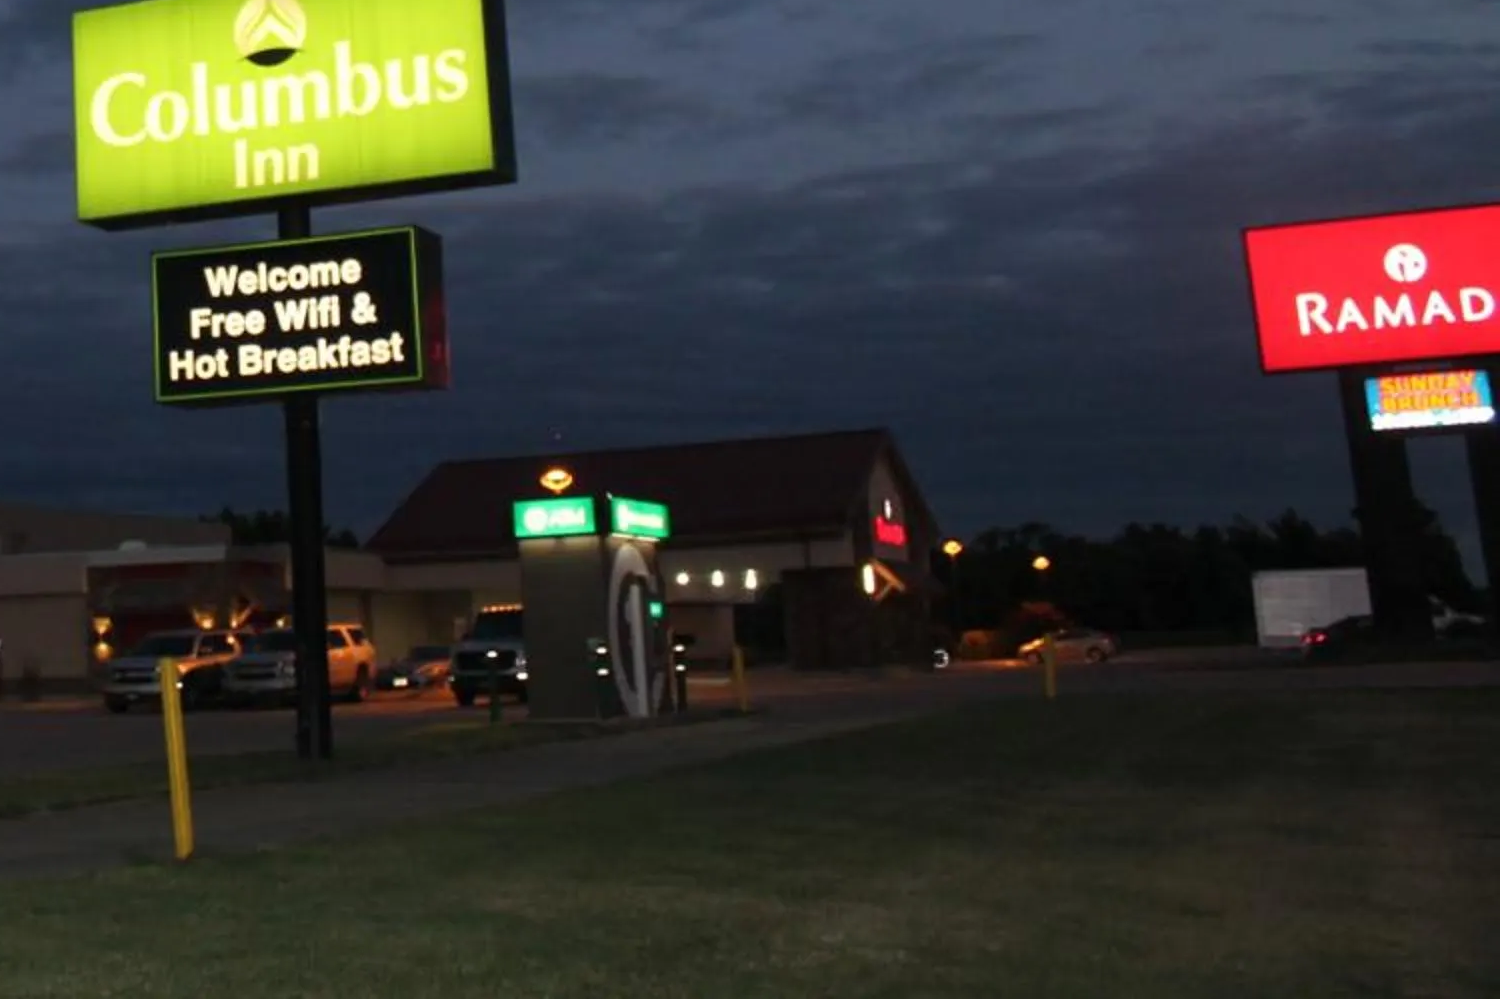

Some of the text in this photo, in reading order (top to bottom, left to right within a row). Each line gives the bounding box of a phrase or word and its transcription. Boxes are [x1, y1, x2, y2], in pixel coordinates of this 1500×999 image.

[89, 40, 469, 147] Columbus
[234, 138, 320, 189] Inn
[204, 257, 362, 298] Welcome
[189, 292, 377, 340] Free Wifi &
[1295, 287, 1495, 336] RAMAD
[168, 331, 404, 382] Hot Breakfast
